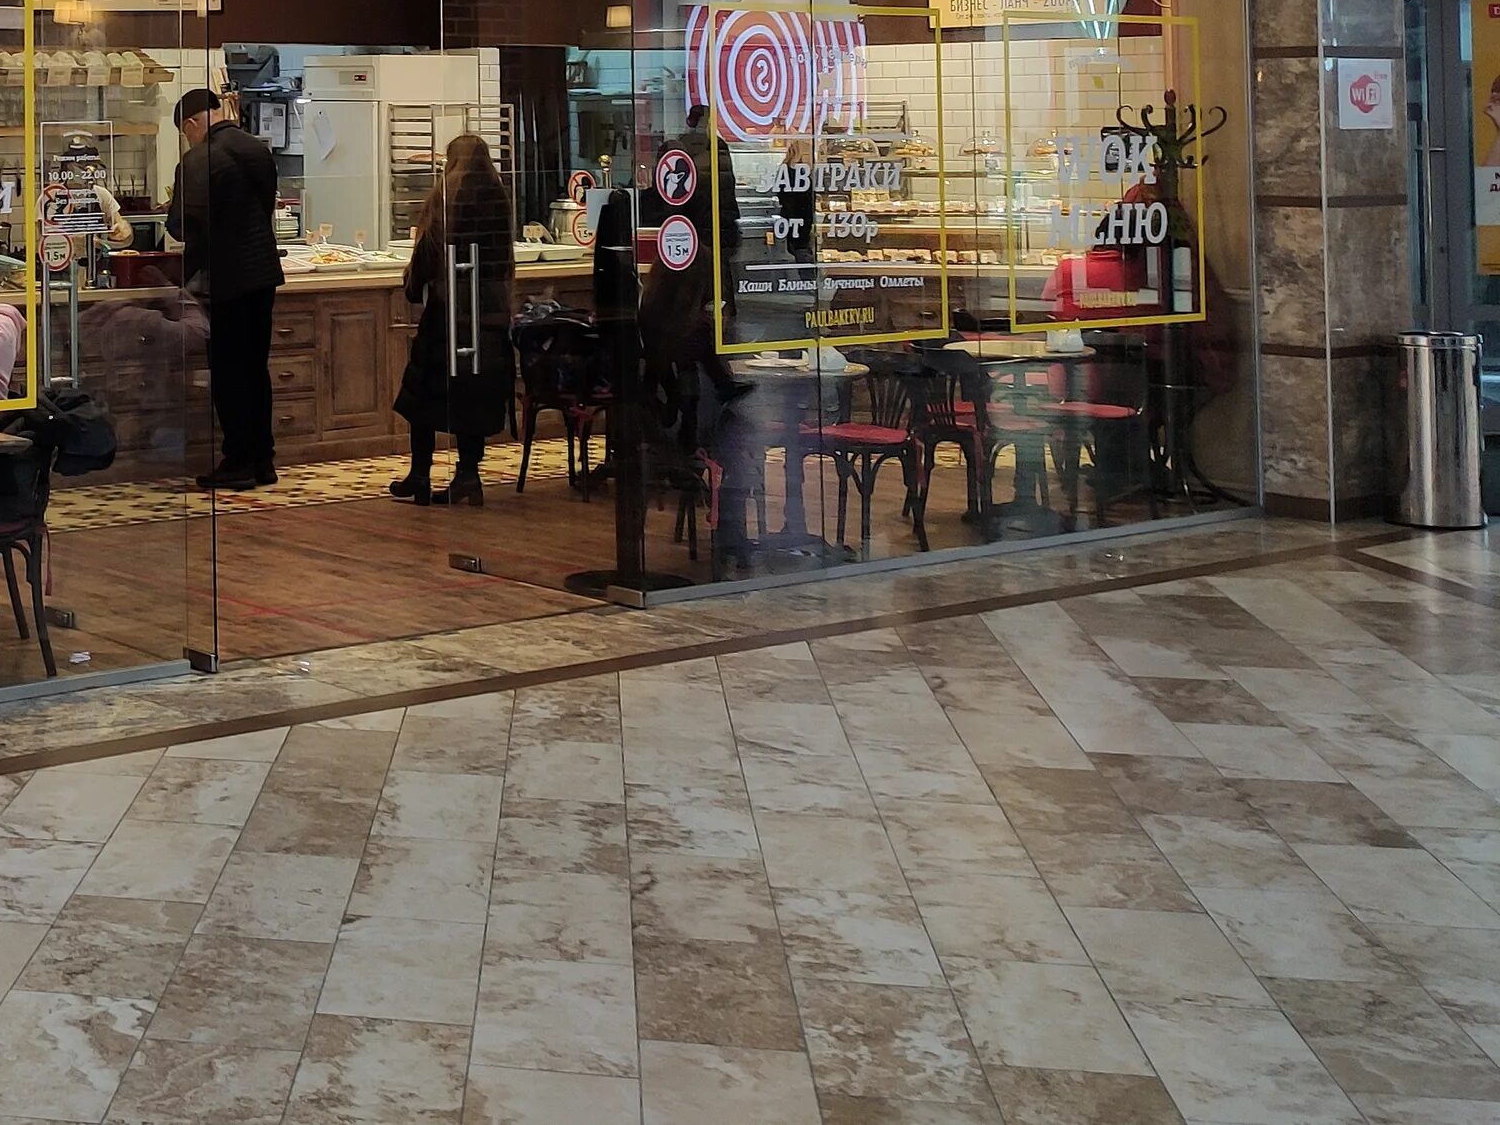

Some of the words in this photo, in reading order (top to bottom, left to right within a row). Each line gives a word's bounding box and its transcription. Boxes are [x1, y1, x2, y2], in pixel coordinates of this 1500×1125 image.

[755, 162, 902, 193] ЗАВТРАКИ
[774, 218, 804, 239] от
[738, 279, 773, 293] Каши
[778, 278, 817, 292] Блины
[880, 275, 924, 288] Омлеты
